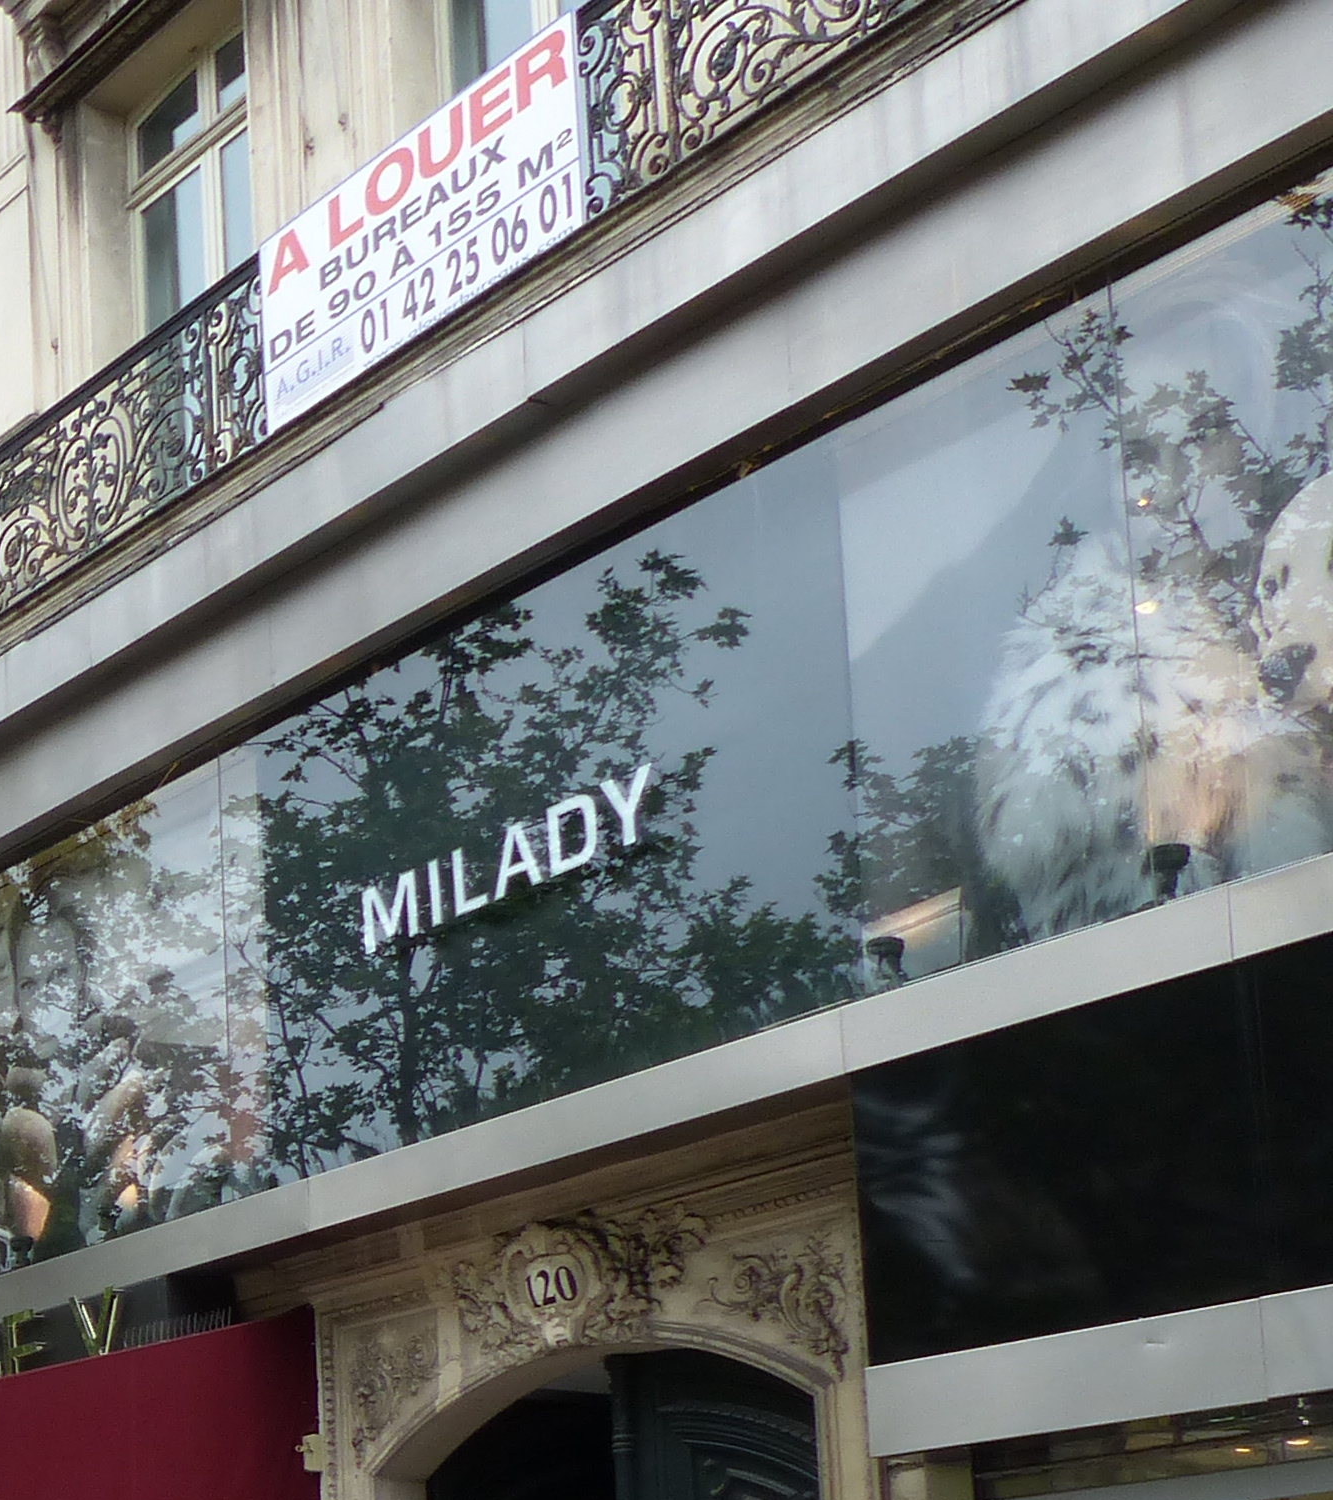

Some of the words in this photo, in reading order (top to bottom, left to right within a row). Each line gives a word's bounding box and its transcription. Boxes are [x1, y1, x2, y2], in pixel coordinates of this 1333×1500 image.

[267, 229, 311, 298] A
[327, 29, 570, 252] LOUER
[318, 134, 508, 292] BUREAUX
[268, 309, 316, 364] DE
[329, 269, 377, 319] 90
[389, 240, 416, 279] À
[428, 179, 502, 249] 155
[360, 297, 390, 356] 01
[402, 265, 438, 322] 42
[447, 237, 481, 298] 25
[490, 206, 529, 267] 06
[538, 172, 574, 235] 01
[361, 762, 652, 955] MILADY
[68, 1285, 124, 1357] V
[525, 1266, 578, 1308] 120
